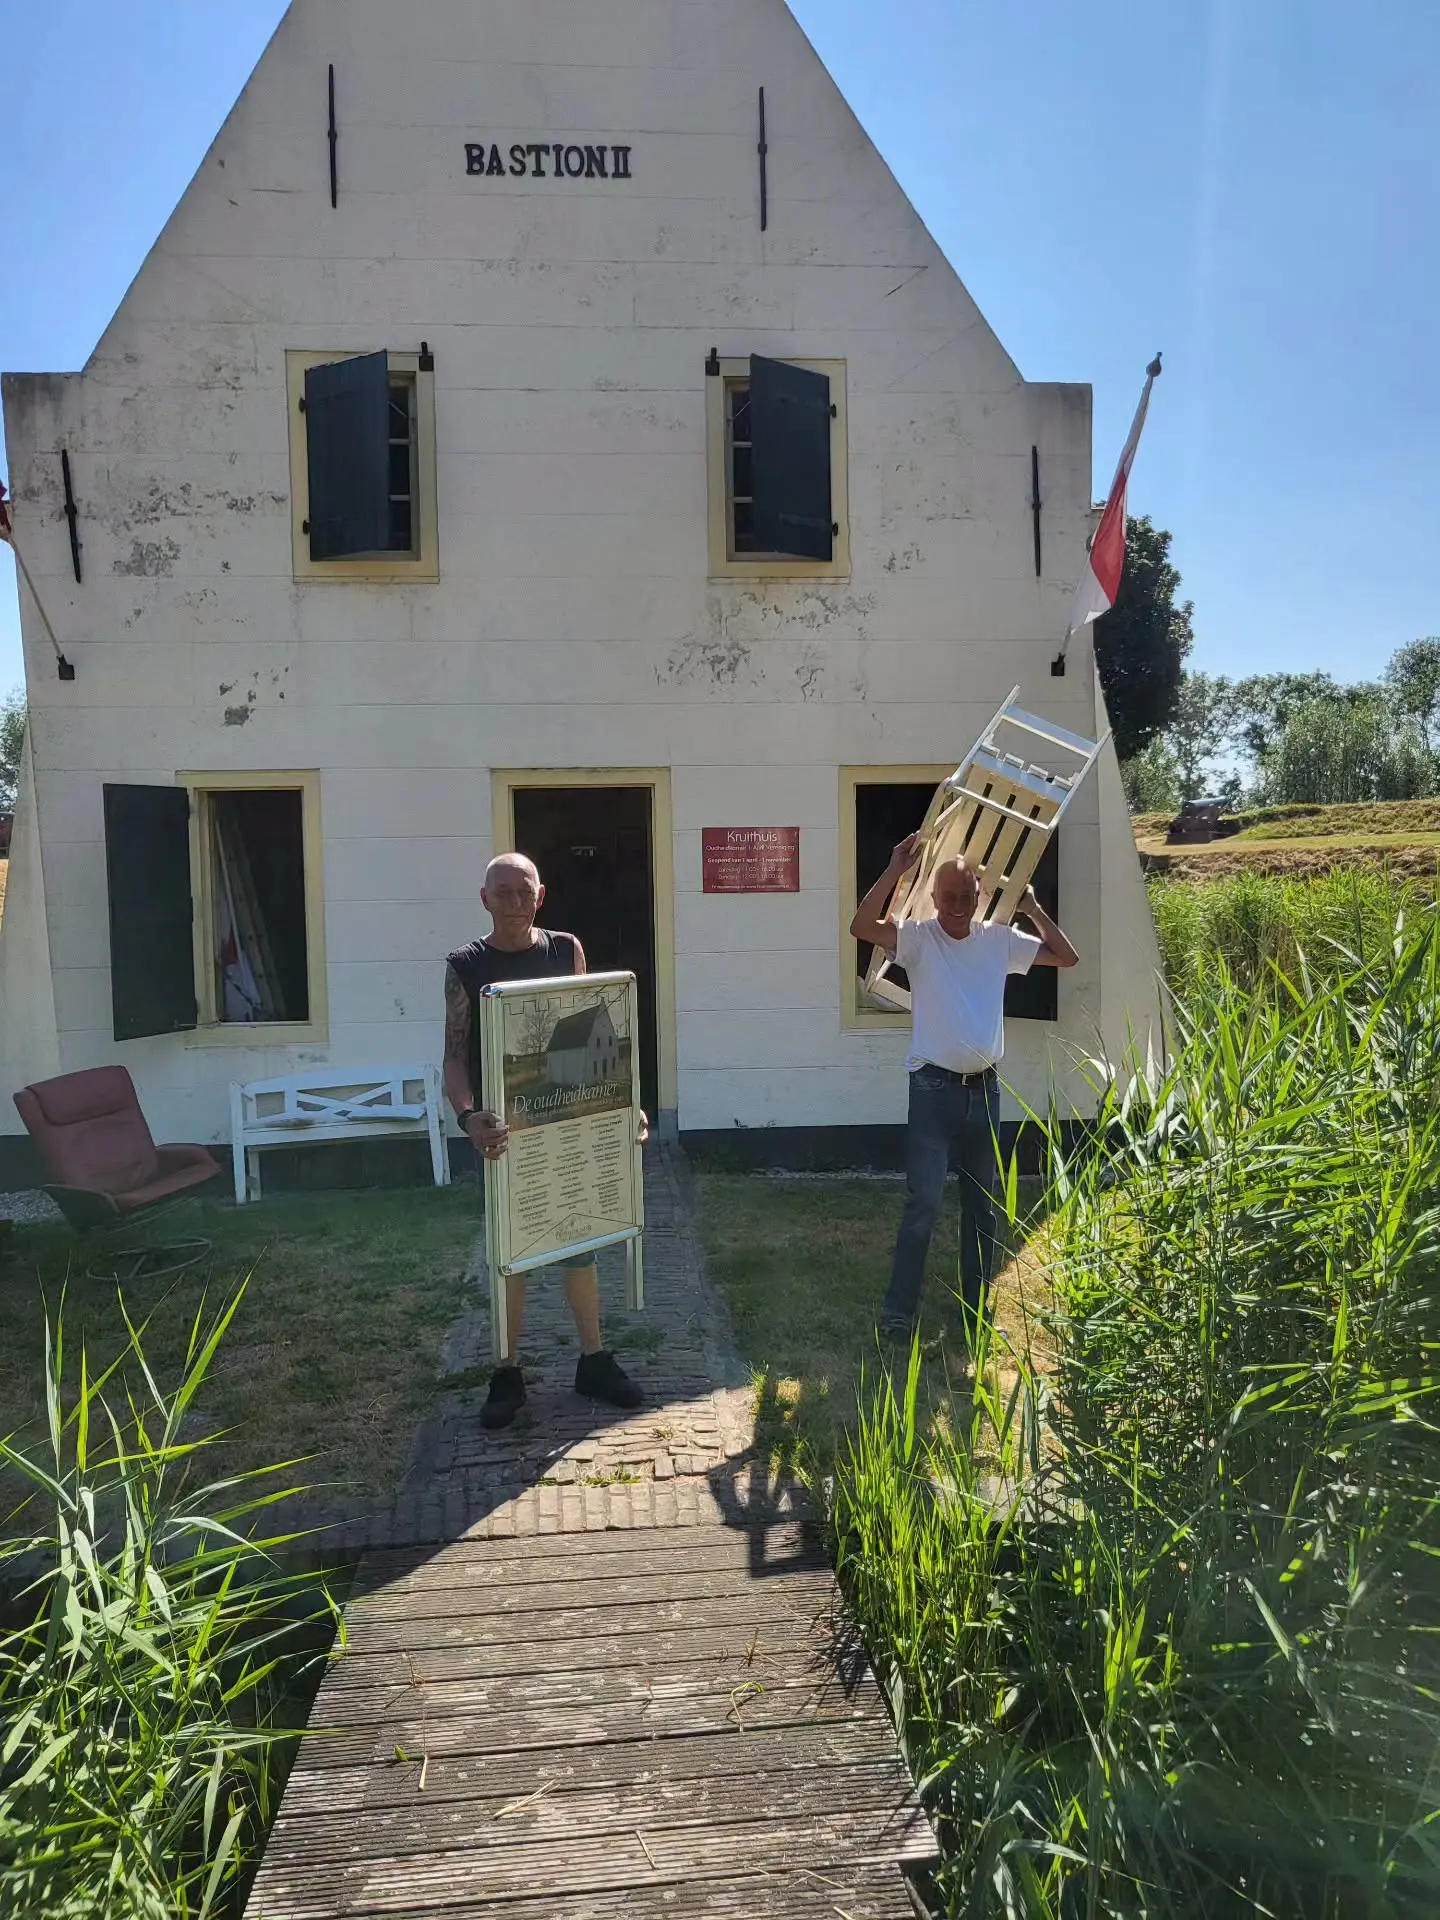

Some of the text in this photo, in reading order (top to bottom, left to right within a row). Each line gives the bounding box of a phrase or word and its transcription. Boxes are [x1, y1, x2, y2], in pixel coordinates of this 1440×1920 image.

[464, 144, 632, 178] BASTION II
[727, 831, 777, 842] Kruithuis
[513, 1095, 532, 1114] De
[533, 1082, 618, 1111] oudheidkamer
